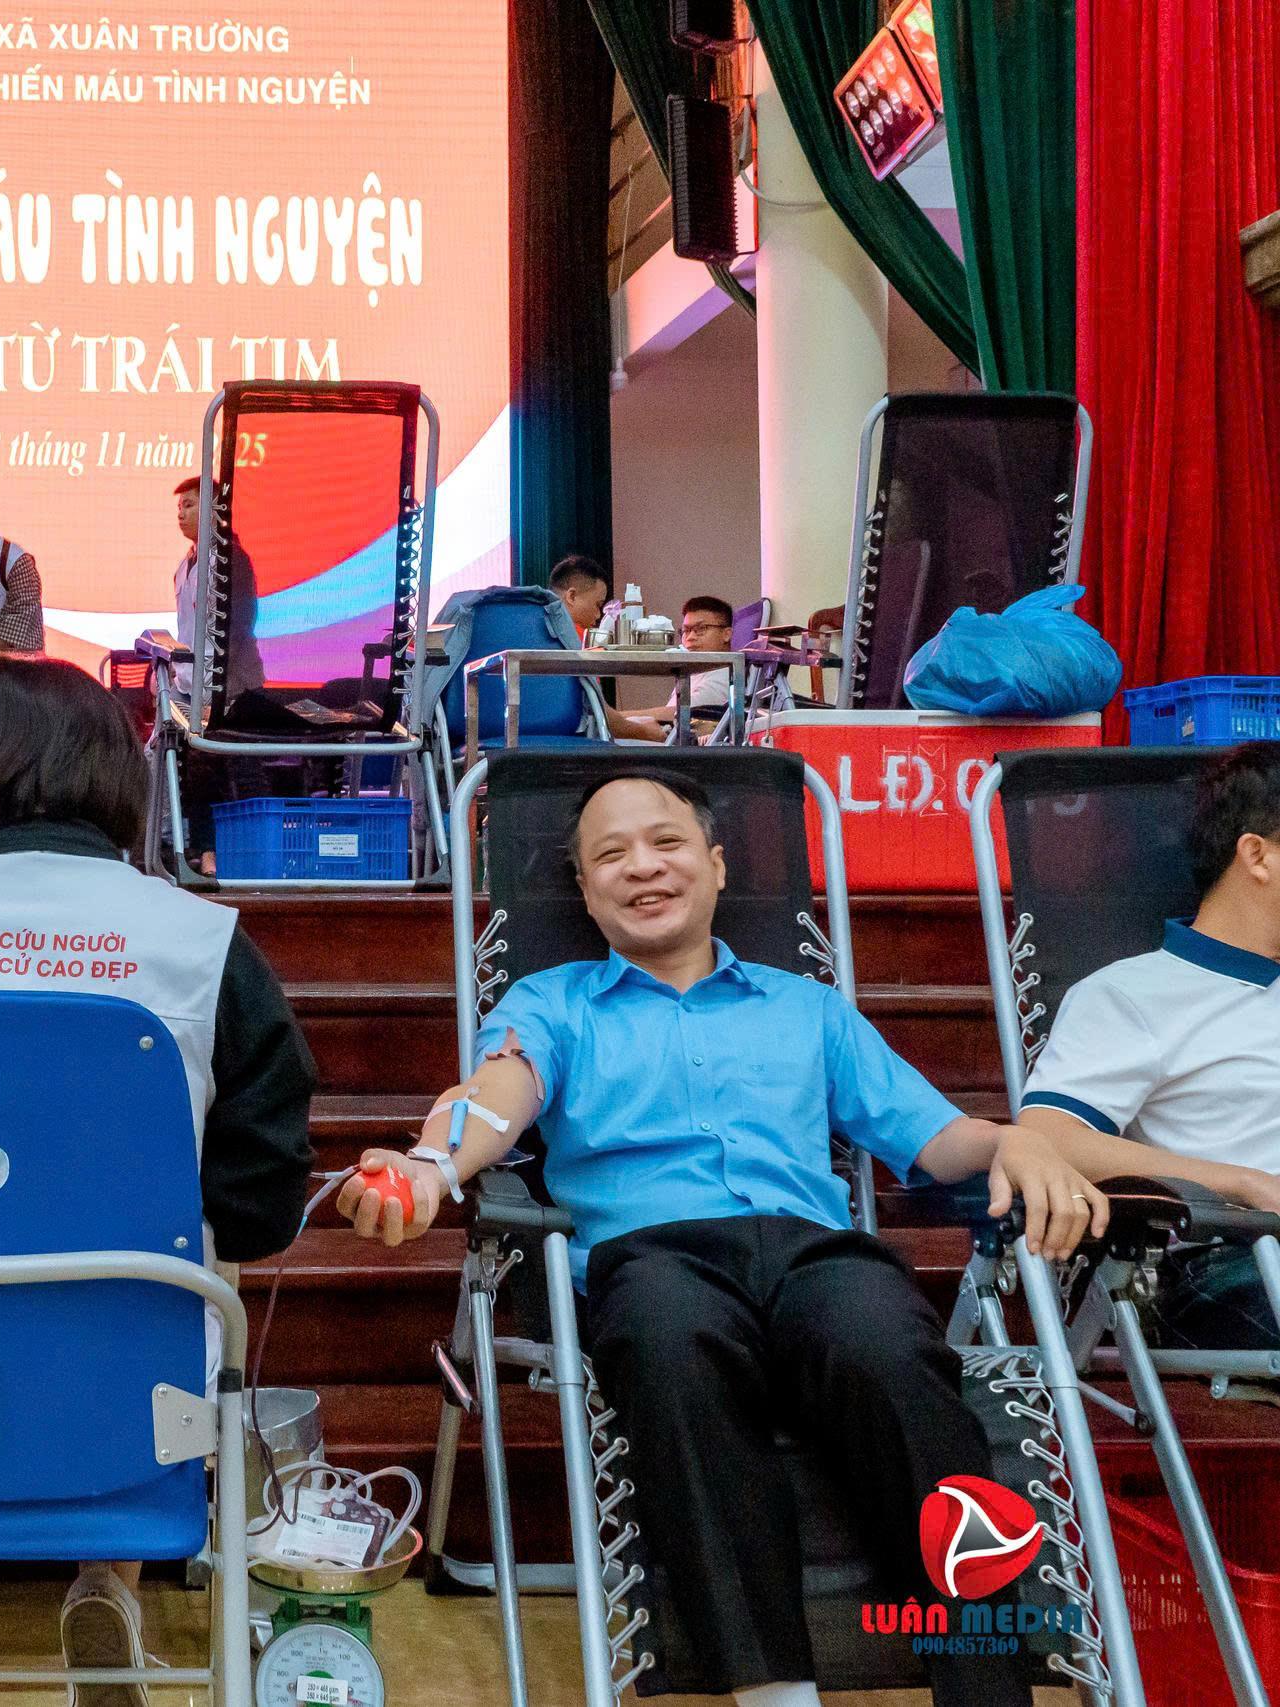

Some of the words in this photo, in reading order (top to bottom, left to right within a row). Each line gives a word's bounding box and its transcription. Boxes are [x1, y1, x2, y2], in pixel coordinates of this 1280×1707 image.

[48, 17, 139, 51] XUÂN
[149, 18, 289, 53] TRƯỜNG
[74, 68, 144, 103] MÁU
[152, 68, 227, 103] TÌNH
[237, 71, 371, 111] NGUYỆN
[71, 169, 195, 285] TÌNH
[215, 171, 423, 308] NGUYỆN
[71, 322, 216, 395] TRÁI
[229, 333, 341, 382] TIM
[8, 431, 88, 477] tháng
[96, 431, 126, 467] 11
[134, 433, 195, 468] năm
[52, 931, 127, 953] NGƯỜI
[36, 959, 85, 979] CAO
[91, 961, 138, 983] ĐẸP
